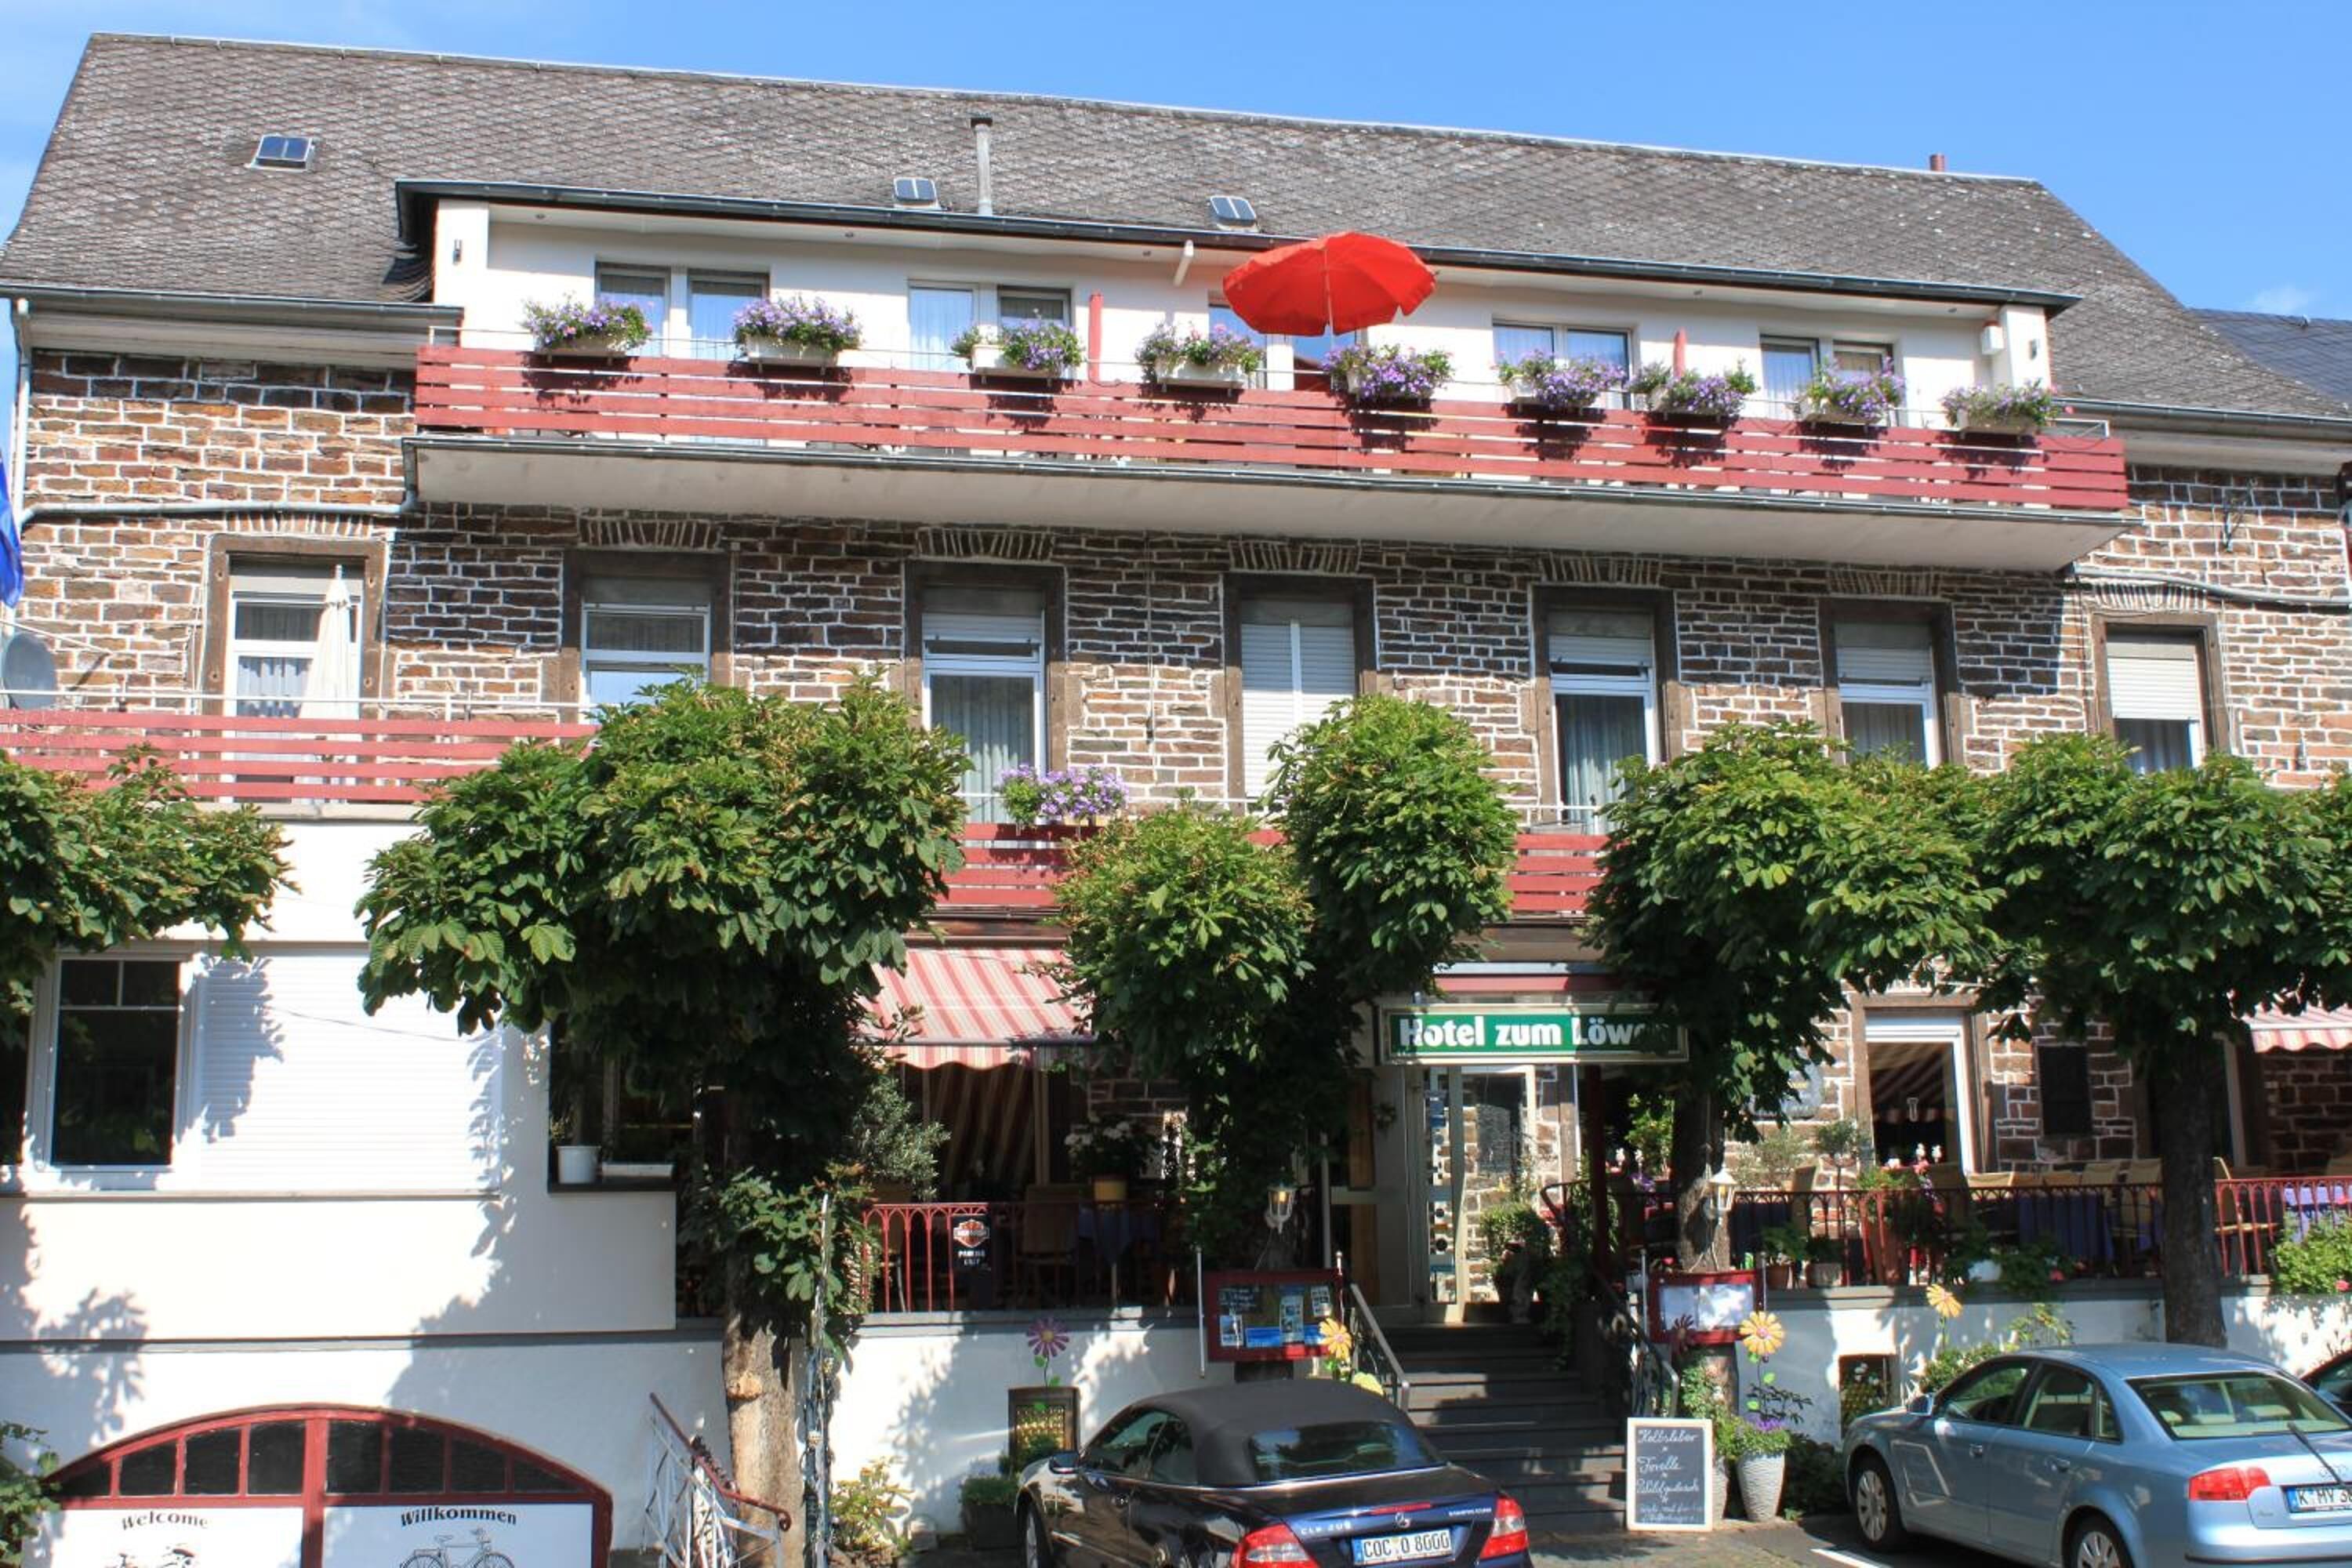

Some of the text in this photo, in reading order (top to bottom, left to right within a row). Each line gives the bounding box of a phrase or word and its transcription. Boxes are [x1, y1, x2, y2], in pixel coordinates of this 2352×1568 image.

[1399, 1016, 1656, 1046] Hotel zum Löw
[122, 1511, 209, 1530] Welcome
[401, 1506, 517, 1526] Willkommen
[1363, 1539, 1392, 1558] COC
